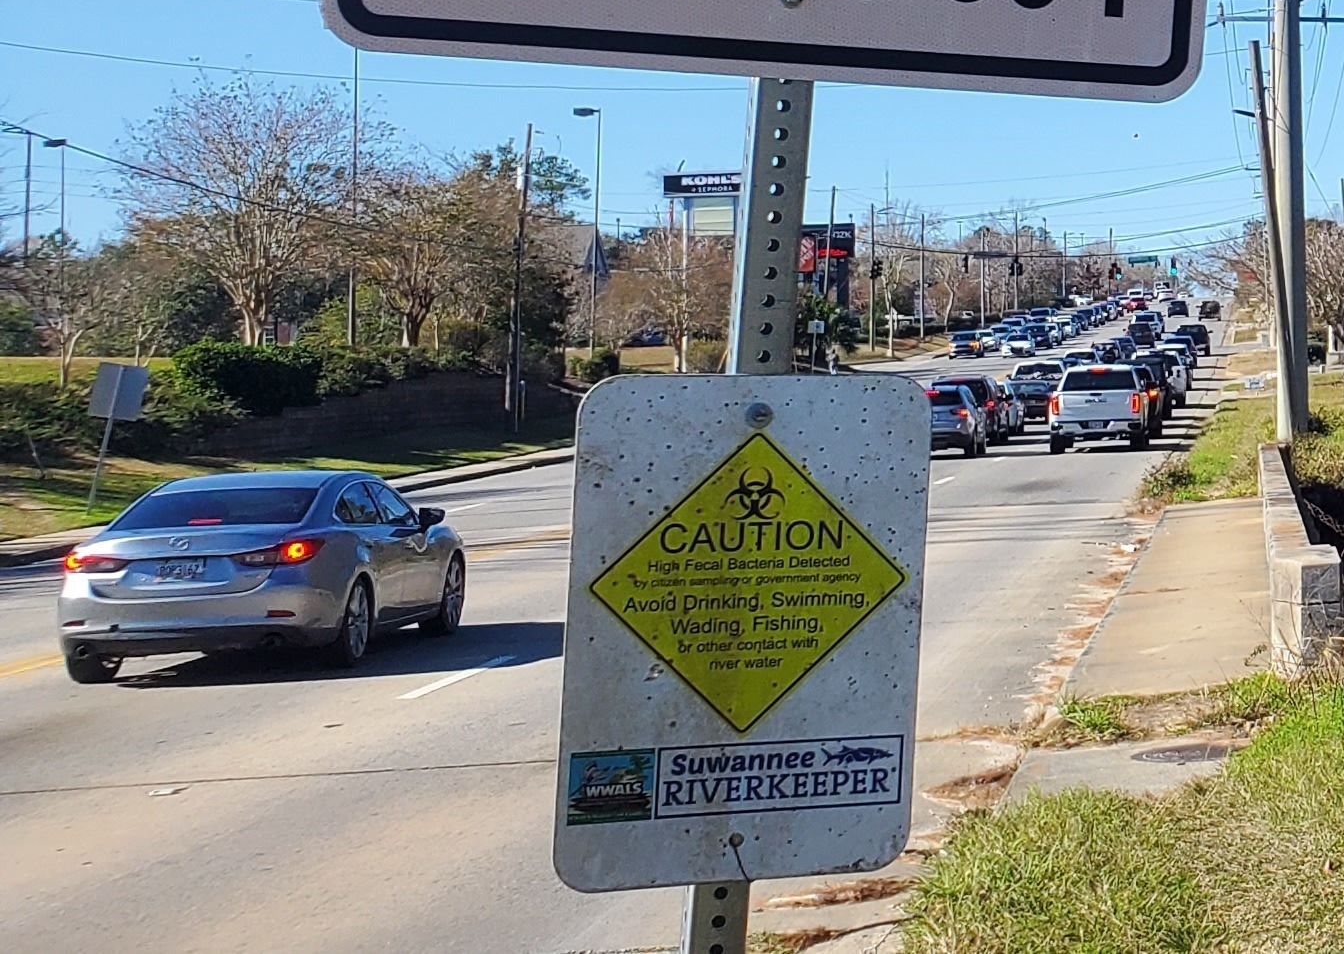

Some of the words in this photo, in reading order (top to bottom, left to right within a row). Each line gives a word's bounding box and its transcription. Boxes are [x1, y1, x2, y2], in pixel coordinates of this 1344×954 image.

[681, 174, 741, 186] KOHL'S
[697, 185, 733, 193] SEPHORA
[660, 520, 844, 554] CAUTION
[648, 559, 680, 575] High
[684, 557, 724, 572] Fecal
[728, 556, 784, 570] Bacteria
[789, 554, 850, 569] Detected
[634, 577, 648, 589] by
[651, 576, 686, 588] citizen
[689, 575, 739, 588] sampling
[740, 576, 753, 585] or
[756, 573, 820, 586] government
[822, 573, 861, 584] agency
[623, 595, 677, 613] Avoid
[683, 593, 765, 613] Drinking,
[771, 591, 870, 609] Swimming,
[670, 616, 745, 638] Wading,
[753, 614, 823, 634] Fishing,
[678, 642, 694, 654] or
[697, 640, 734, 653] other
[737, 636, 787, 651] contact
[791, 635, 819, 649] with
[709, 659, 744, 671] river
[744, 656, 783, 670] water
[671, 750, 816, 776] Suwannee
[586, 782, 642, 797] WWALS
